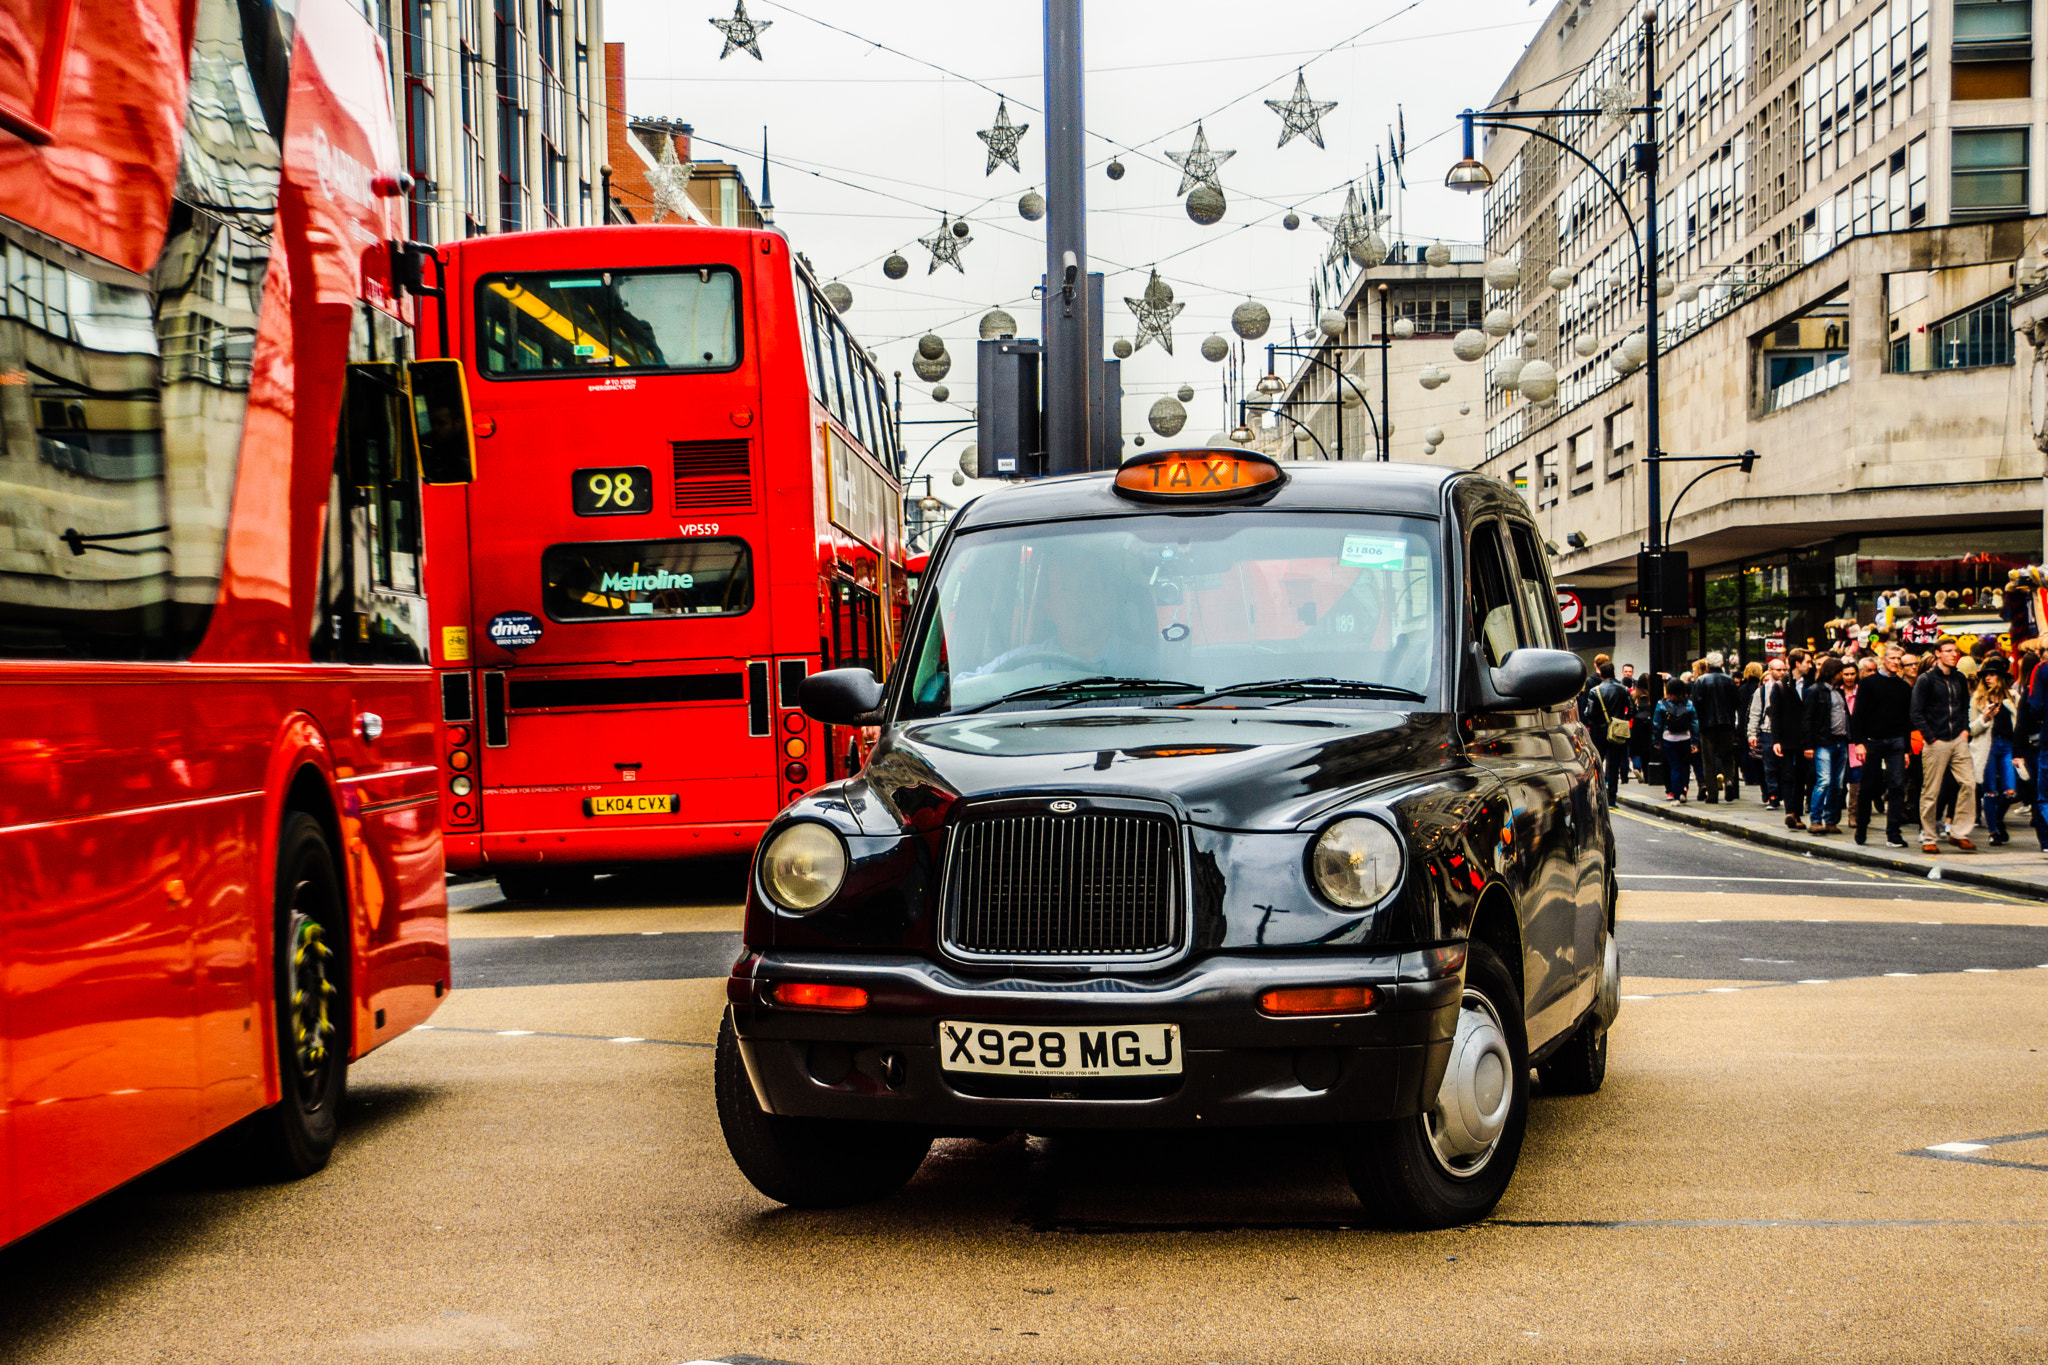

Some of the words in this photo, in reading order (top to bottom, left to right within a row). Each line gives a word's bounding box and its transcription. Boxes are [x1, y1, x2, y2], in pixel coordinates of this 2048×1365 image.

[1148, 461, 1239, 487] TAXI
[589, 473, 635, 508] 98
[679, 523, 719, 536] VP559
[1346, 546, 1383, 556] 61806
[601, 569, 693, 592] Metroline
[491, 621, 541, 636] drive...
[596, 798, 633, 812] LK04
[638, 797, 666, 810] CVX
[948, 1025, 1067, 1068] X928
[1079, 1028, 1173, 1068] MGJ
